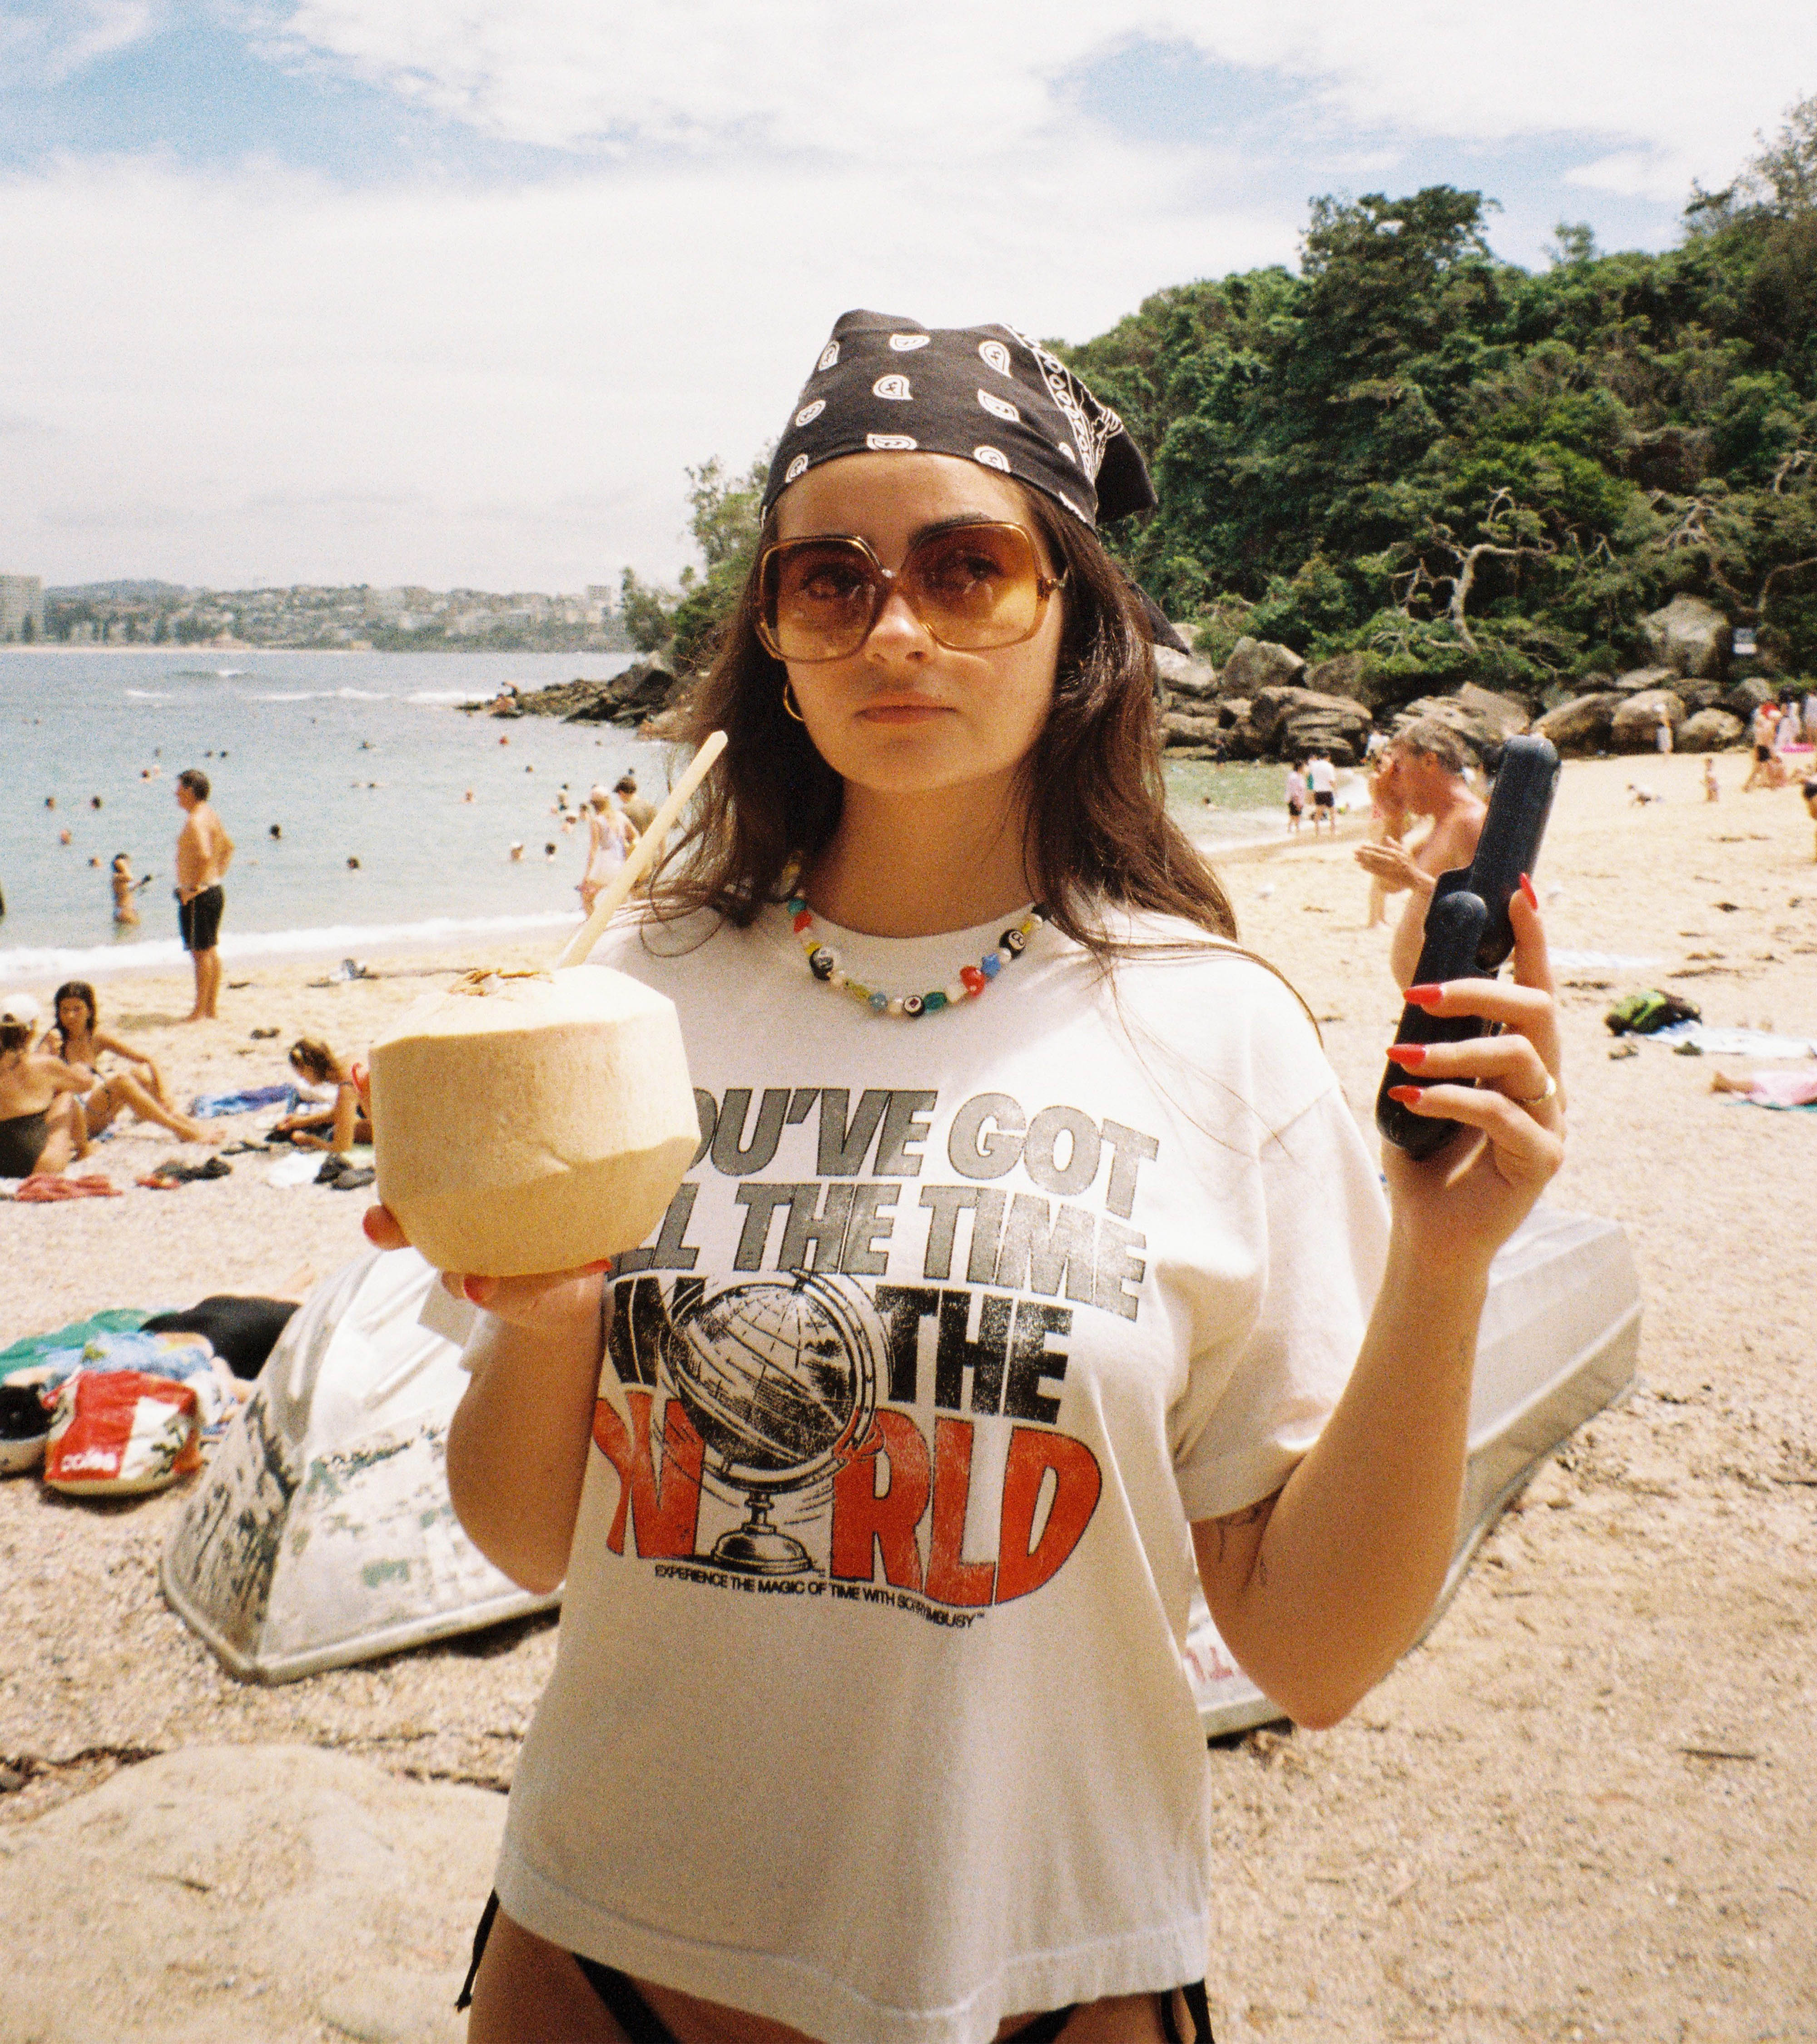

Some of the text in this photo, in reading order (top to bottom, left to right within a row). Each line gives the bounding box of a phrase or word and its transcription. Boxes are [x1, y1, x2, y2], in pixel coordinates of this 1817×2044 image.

[948, 1093, 1159, 1220] GOT
[733, 1182, 902, 1276] THE
[918, 1185, 1147, 1323] TIME
[874, 1284, 1074, 1424] THE
[655, 1564, 728, 1588] EXPERIENCE
[730, 1576, 756, 1592] THE
[758, 1579, 806, 1595] MAGIC
[807, 1581, 826, 1596] OF
[829, 1583, 860, 1600] TIME
[862, 1588, 895, 1607] WITH
